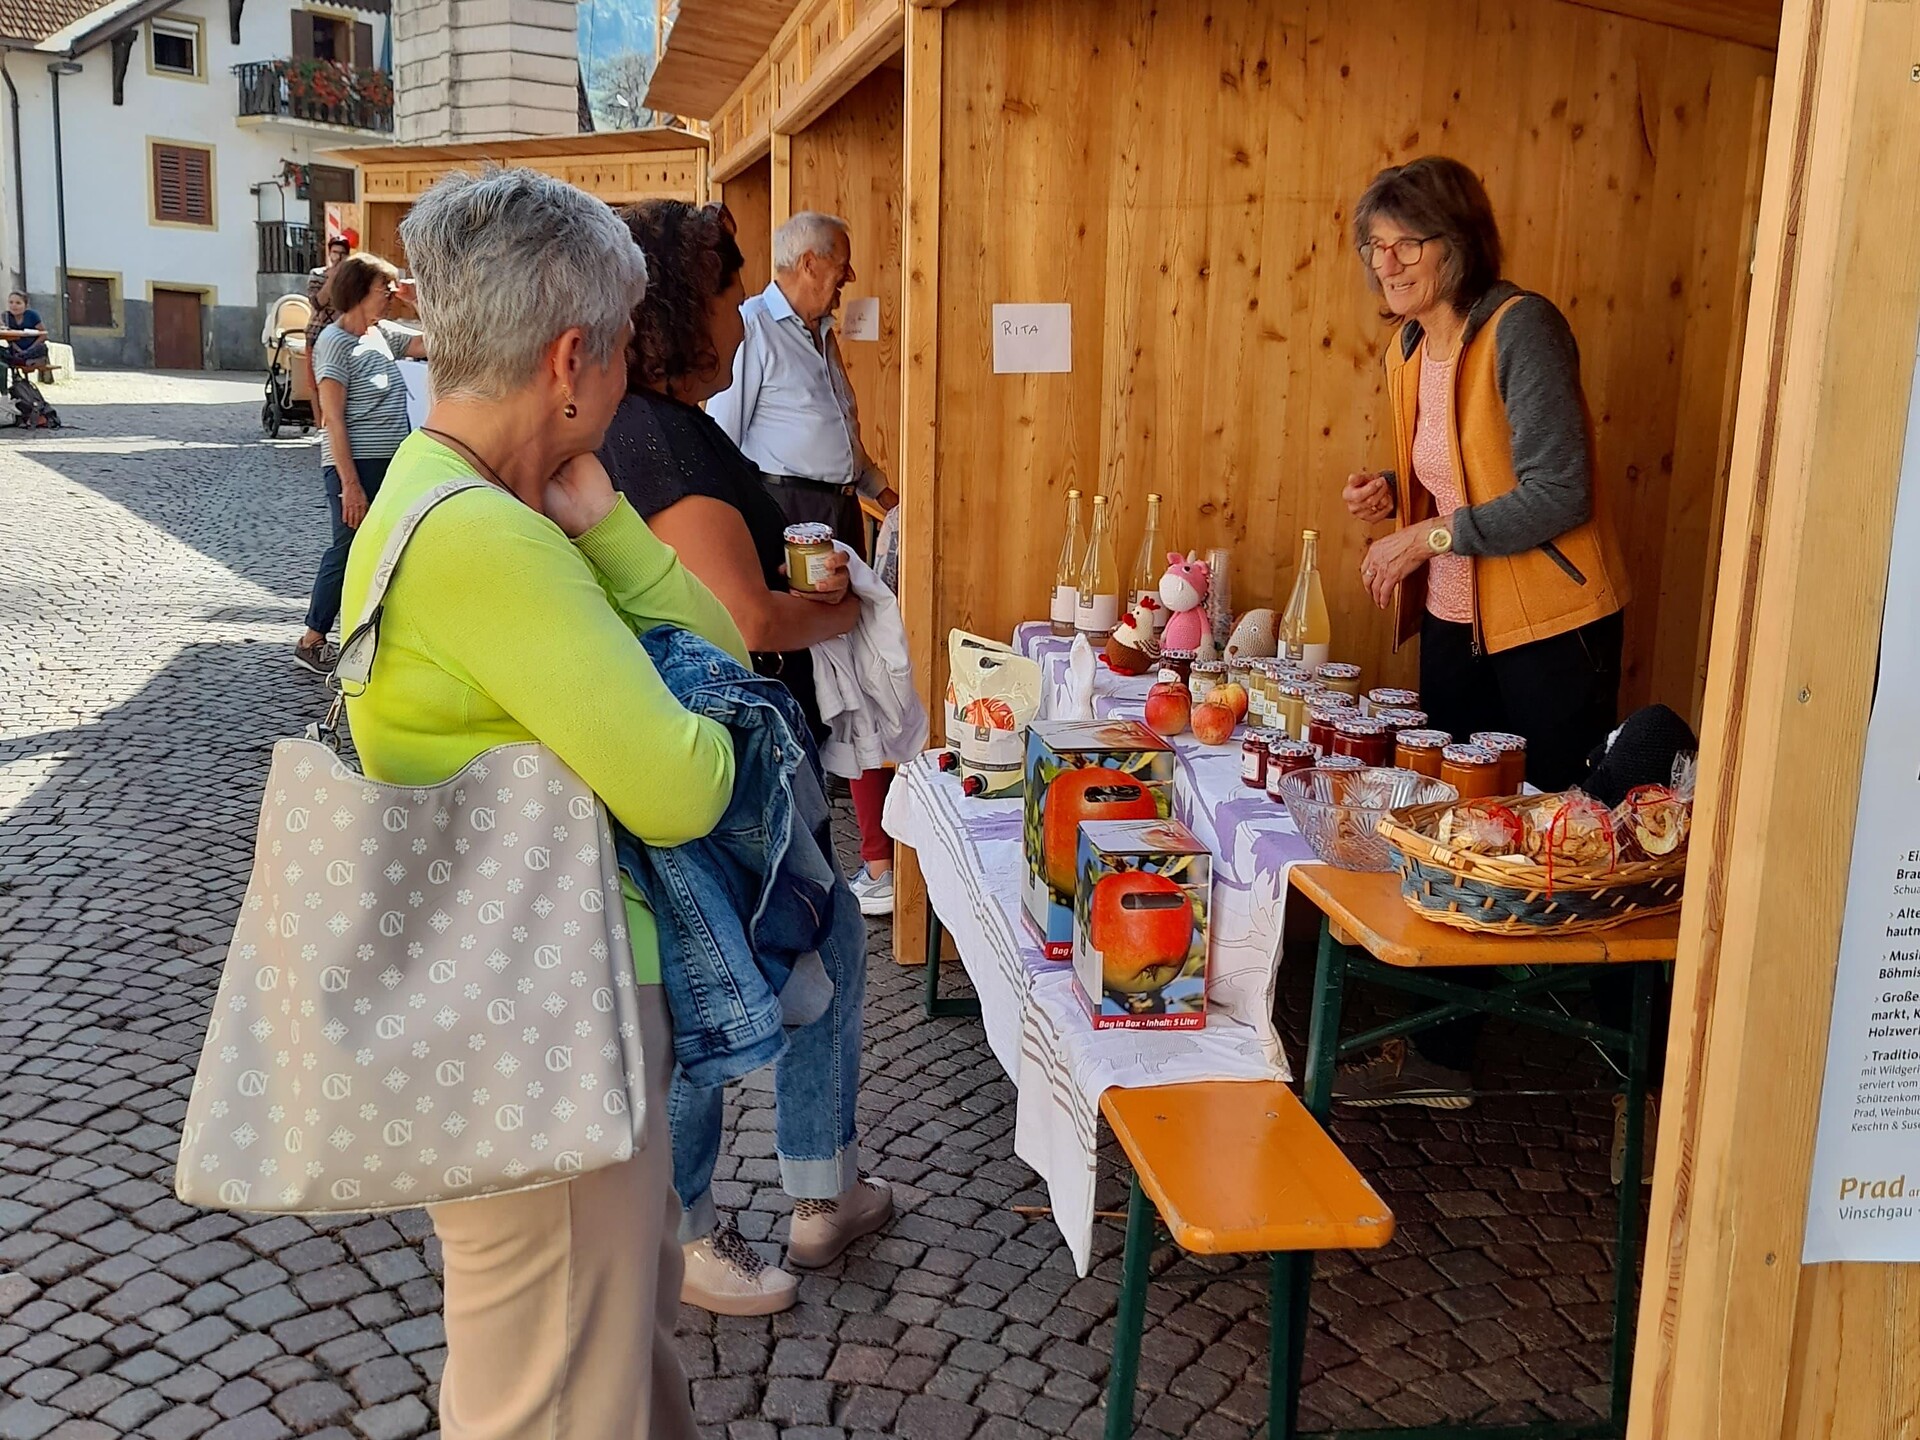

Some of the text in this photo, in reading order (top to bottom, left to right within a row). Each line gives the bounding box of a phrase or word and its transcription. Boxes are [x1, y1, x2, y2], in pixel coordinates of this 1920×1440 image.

[1000, 319, 1039, 336] RITA
[1908, 850, 1920, 862] Ei
[1052, 946, 1069, 957] Bag
[1889, 949, 1920, 961] Musi
[1871, 1008, 1910, 1021] markt,
[1098, 1020, 1115, 1030] Bag
[1124, 1019, 1141, 1028] Box
[1173, 1018, 1179, 1026] 5
[1180, 1017, 1199, 1026] Liter
[1872, 1048, 1920, 1061] Traditio
[1861, 1066, 1877, 1077] mit
[1859, 1080, 1918, 1090] serviert vom
[1853, 1107, 1877, 1118] Prad,
[1851, 1121, 1889, 1132] Keschtn
[1891, 1120, 1899, 1130] &
[1840, 1174, 1906, 1200] Prad
[1839, 1205, 1913, 1221] Vinschgau
